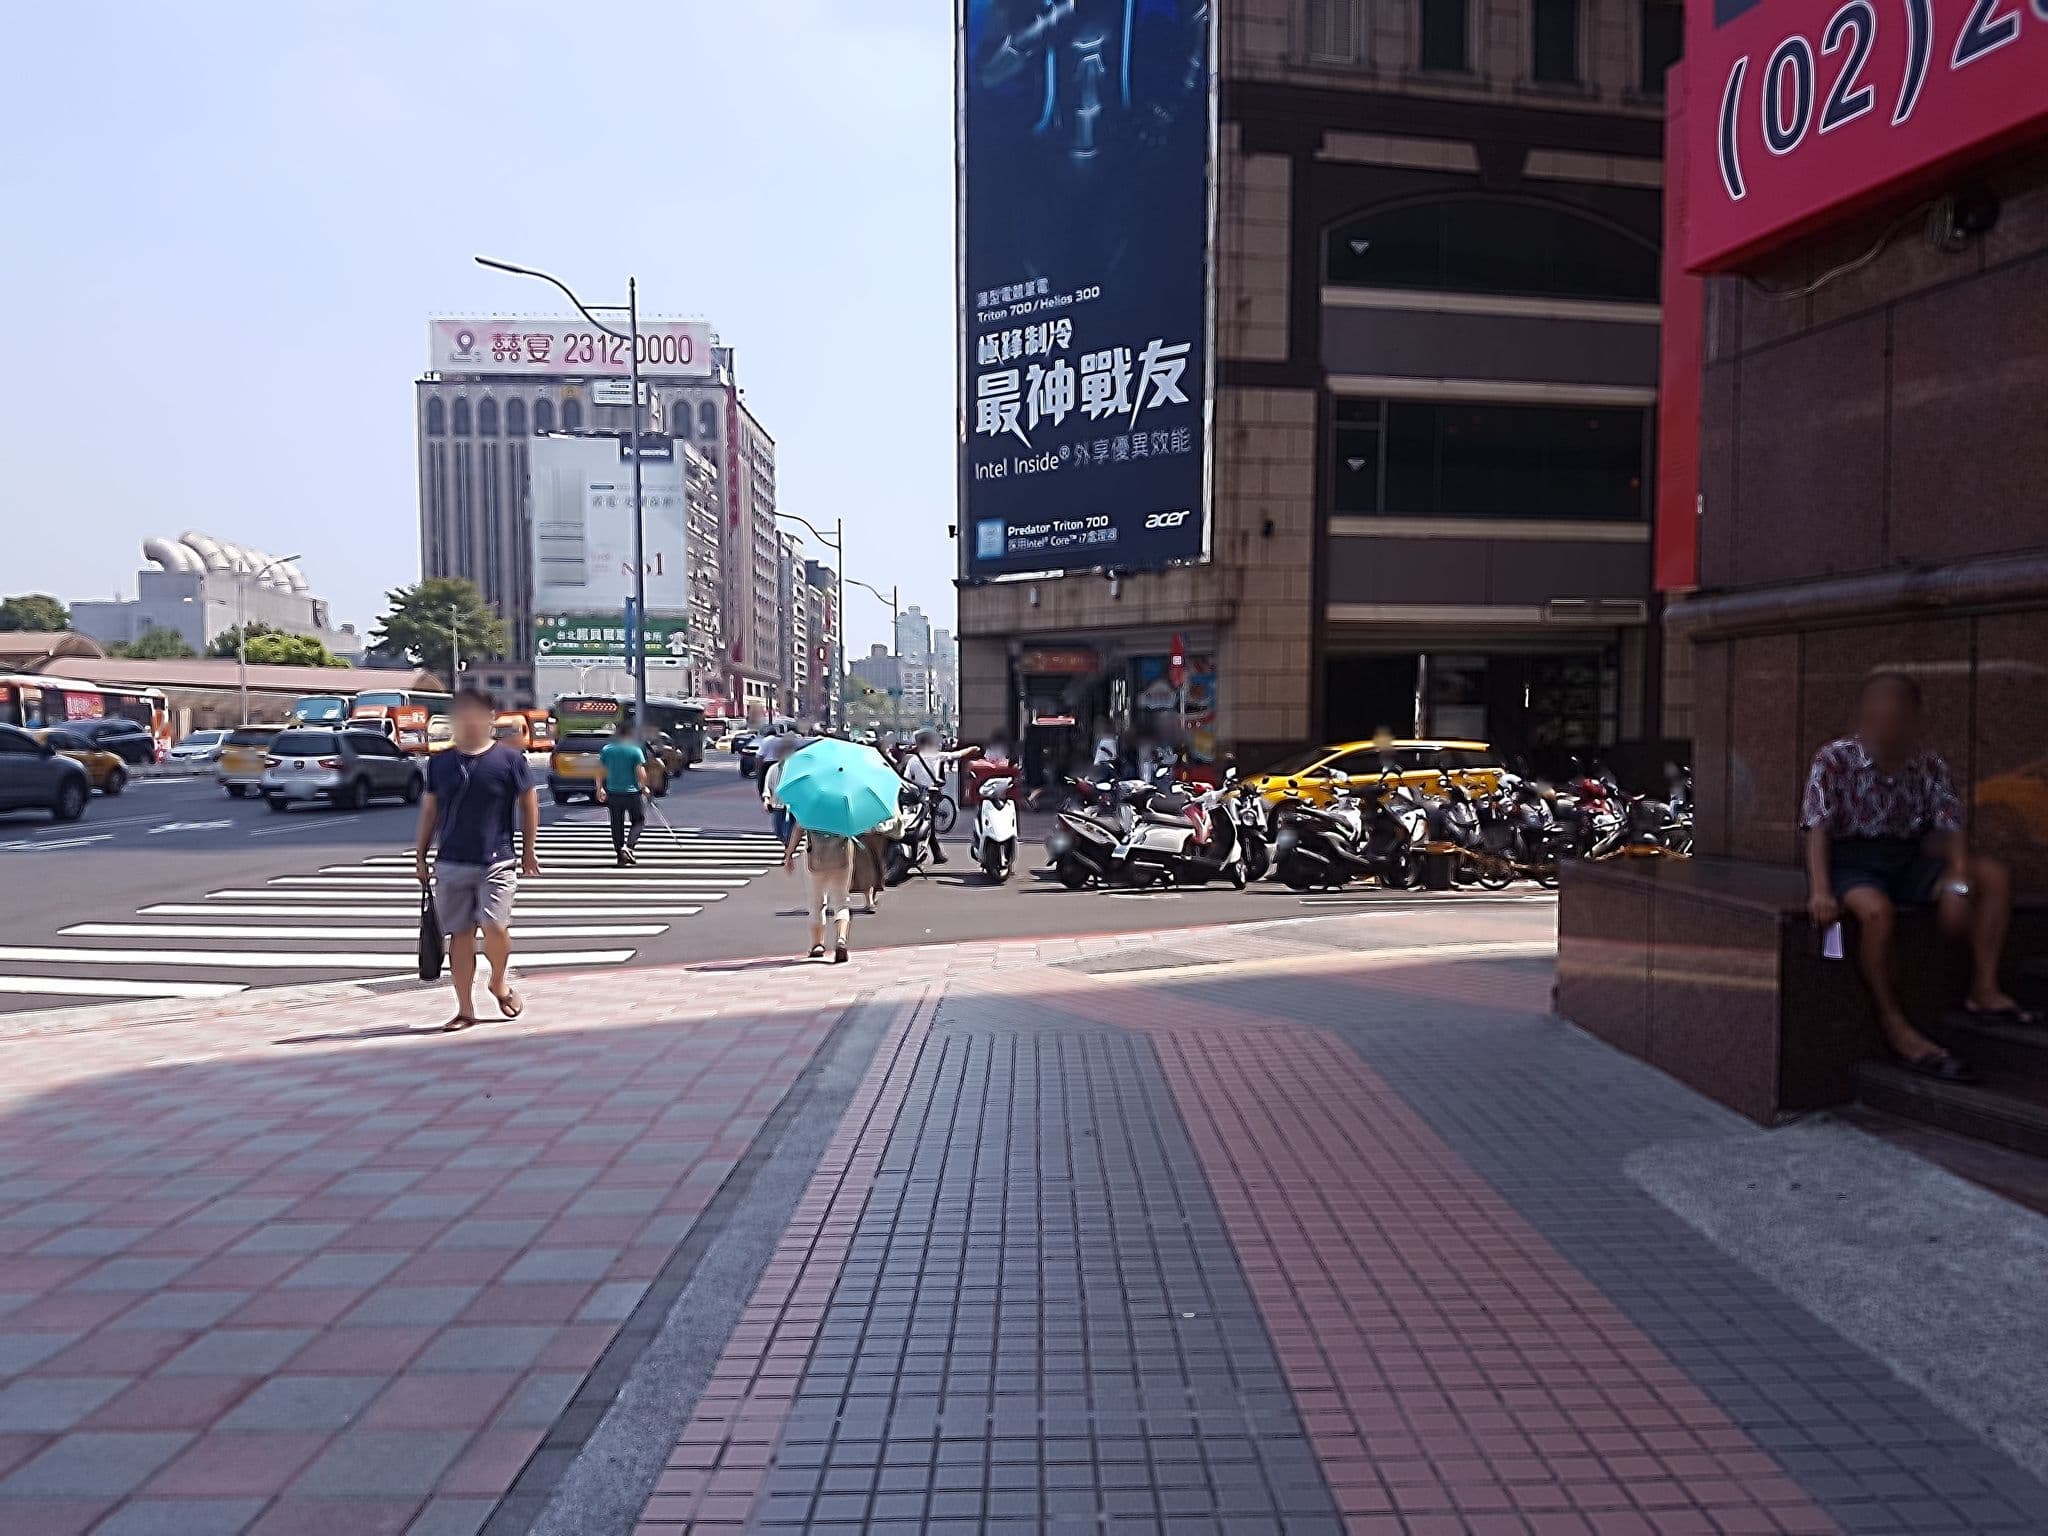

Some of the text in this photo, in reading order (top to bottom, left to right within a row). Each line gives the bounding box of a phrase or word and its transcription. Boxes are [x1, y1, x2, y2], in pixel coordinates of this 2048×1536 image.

[977, 310, 1008, 323] Triton
[1075, 286, 1100, 303] 300
[975, 338, 1192, 449] 最神戰友
[975, 457, 1008, 480] Intel
[1007, 515, 1109, 537] Predator Triton 700
[1144, 510, 1190, 528] acer
